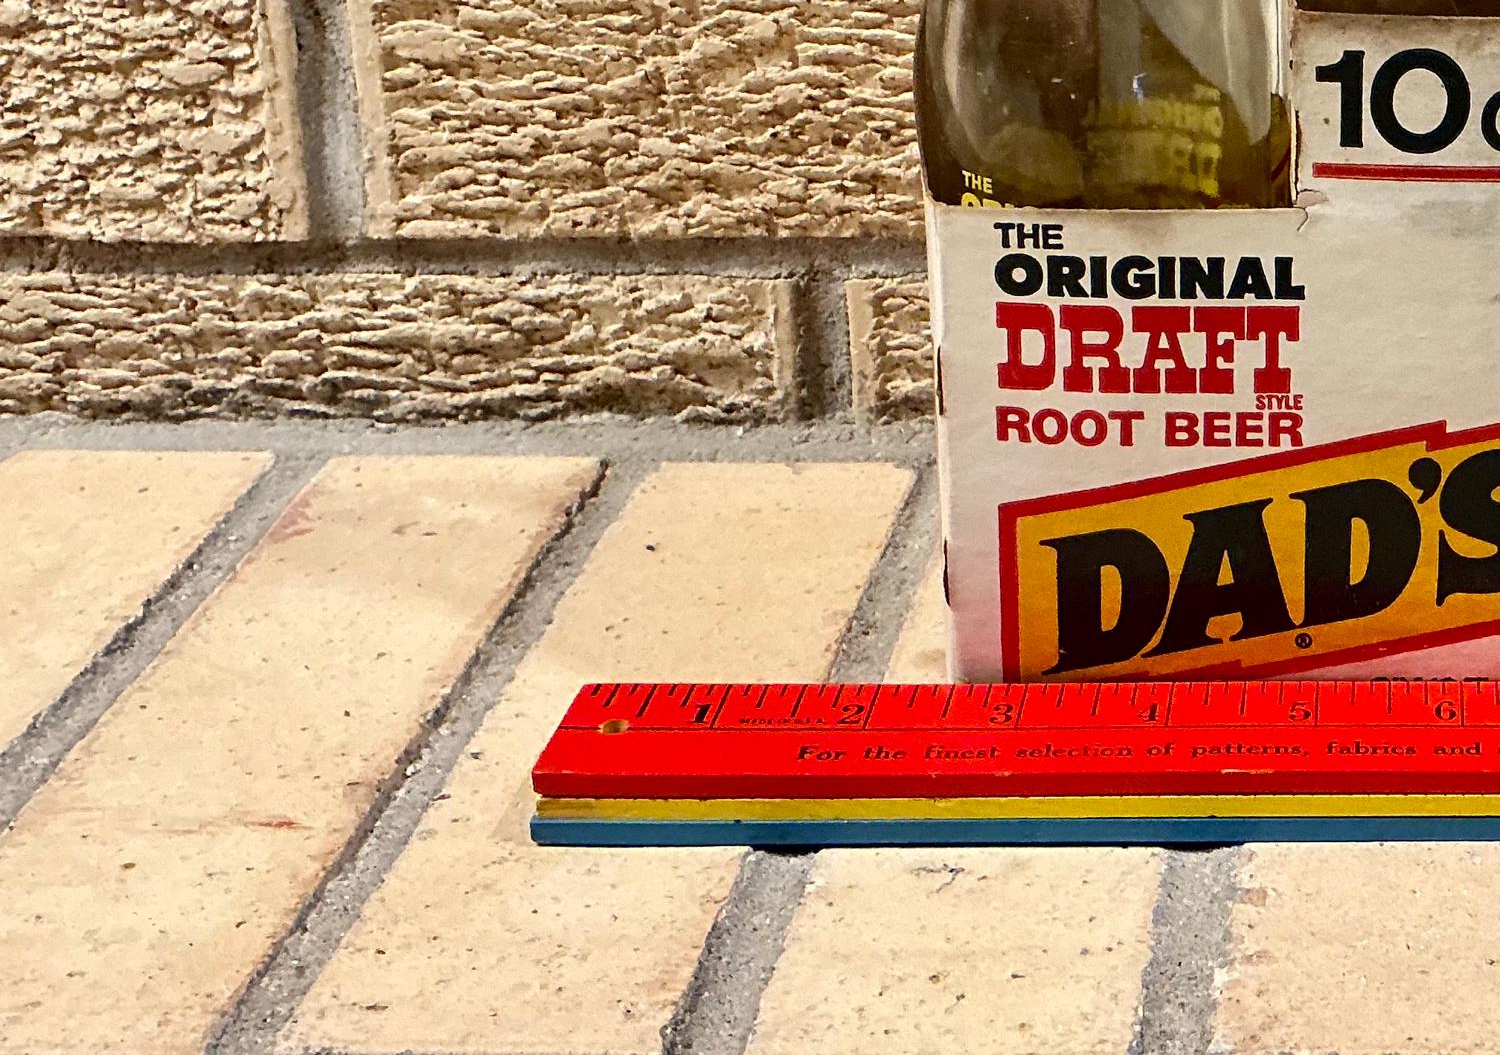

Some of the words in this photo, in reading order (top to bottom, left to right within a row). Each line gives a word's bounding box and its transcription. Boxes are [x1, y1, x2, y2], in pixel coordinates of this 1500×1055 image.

[1315, 48, 1471, 154] 10
[961, 170, 993, 194] THE
[994, 222, 1064, 249] THE
[994, 254, 1306, 300] ORIGINAL
[996, 302, 1300, 394] DRAFT
[1255, 394, 1303, 410] STYLE
[996, 406, 1144, 446] ROOT
[1165, 411, 1304, 447] BEER
[686, 703, 709, 724] 1
[837, 704, 865, 725] 2
[988, 703, 1013, 724] 3
[1137, 702, 1160, 723] 4
[1288, 701, 1312, 723] 5
[1433, 701, 1458, 723] 6
[796, 744, 845, 761] For
[863, 745, 906, 761] the
[923, 744, 1001, 761] finest
[1015, 743, 1133, 759] selection
[1146, 742, 1175, 758] of
[1326, 740, 1417, 757] fabrics
[1434, 742, 1482, 758] and
